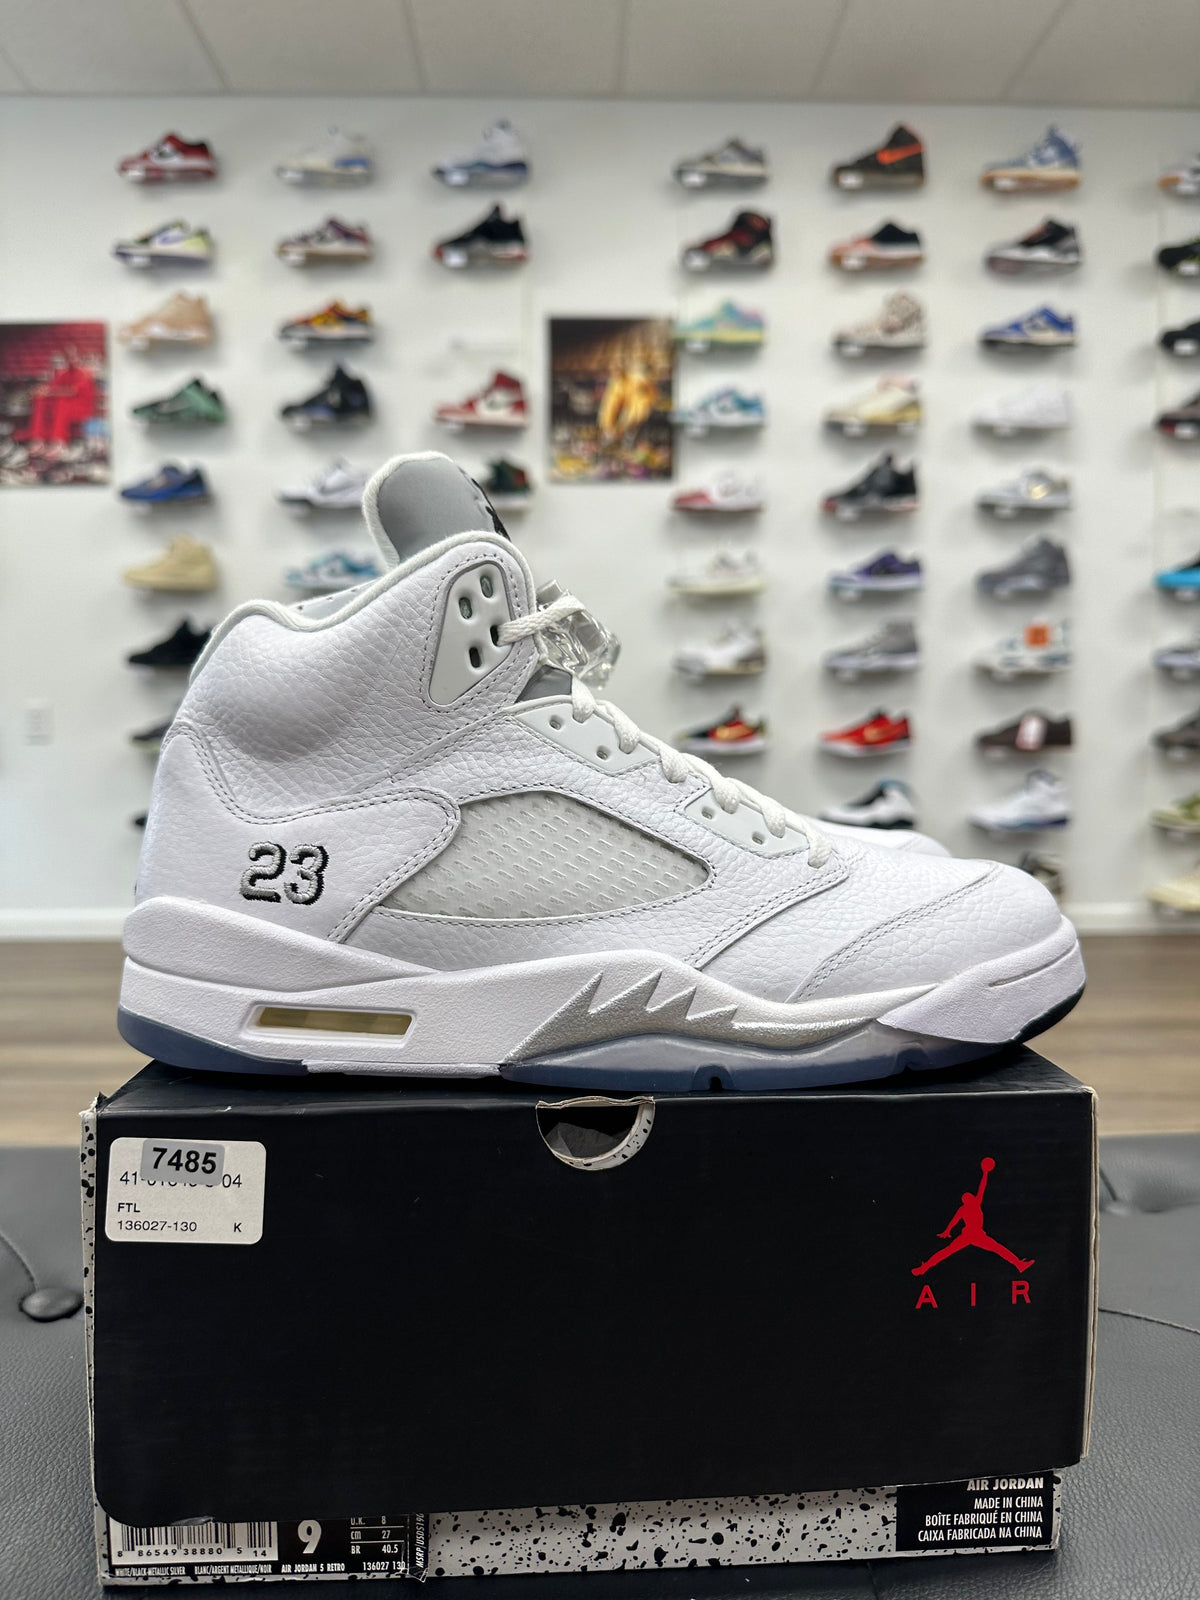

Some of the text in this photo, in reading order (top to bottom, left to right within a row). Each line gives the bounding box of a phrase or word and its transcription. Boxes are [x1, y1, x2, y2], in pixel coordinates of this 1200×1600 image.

[239, 841, 329, 905] 23
[152, 1147, 217, 1174] 7485
[117, 1202, 141, 1213] FTL
[117, 1220, 242, 1233] 136027-130 K
[915, 1280, 1031, 1309] AIR
[967, 1477, 1044, 1491] AIR JORDAN
[974, 1496, 1043, 1510] MADE IN CHINA
[350, 1515, 387, 1526] U.K. 8
[925, 1510, 1043, 1527] BOÎTE FABRIQUÉ EN CHINA
[297, 1519, 322, 1554] 9
[381, 1529, 391, 1540] 27
[918, 1526, 1043, 1542] CAIXA FABRICADA NA CHINA
[117, 1550, 123, 1558] 8
[351, 1543, 399, 1555] BR 40.5
[281, 1564, 292, 1573] AIR
[294, 1563, 318, 1573] JORDAN
[319, 1563, 325, 1572] 5
[326, 1562, 346, 1572] RETRO
[362, 1561, 390, 1571] 136027
[392, 1560, 406, 1570] 130
